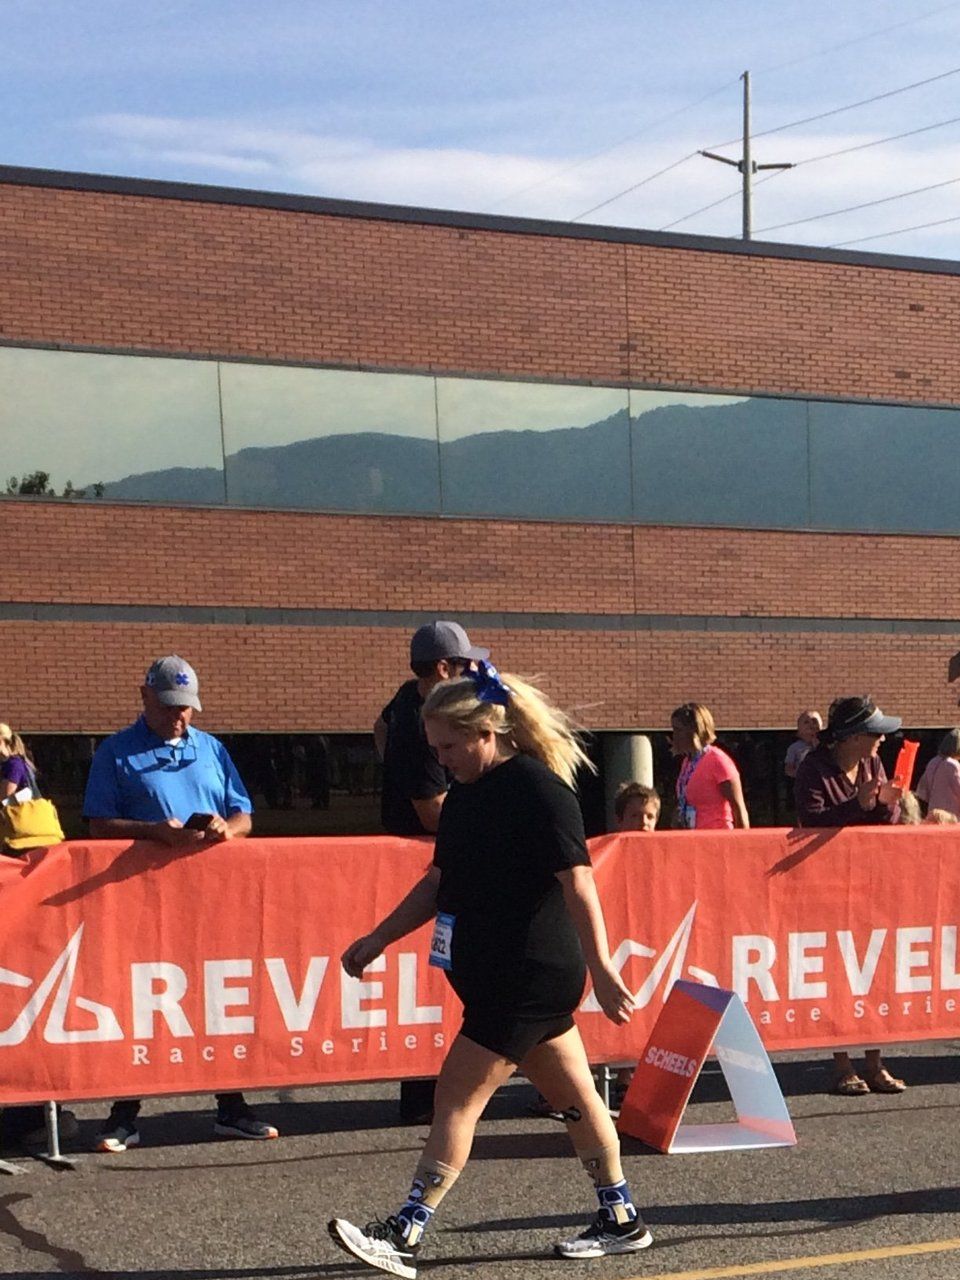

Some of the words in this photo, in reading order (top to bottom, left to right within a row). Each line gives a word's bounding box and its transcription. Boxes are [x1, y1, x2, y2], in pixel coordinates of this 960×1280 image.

[131, 953, 443, 1039] REVEL
[760, 1006, 821, 1025] ace
[132, 1044, 247, 1065] Race
[290, 1031, 445, 1057] Series
[645, 1047, 697, 1078] SCHEELS
